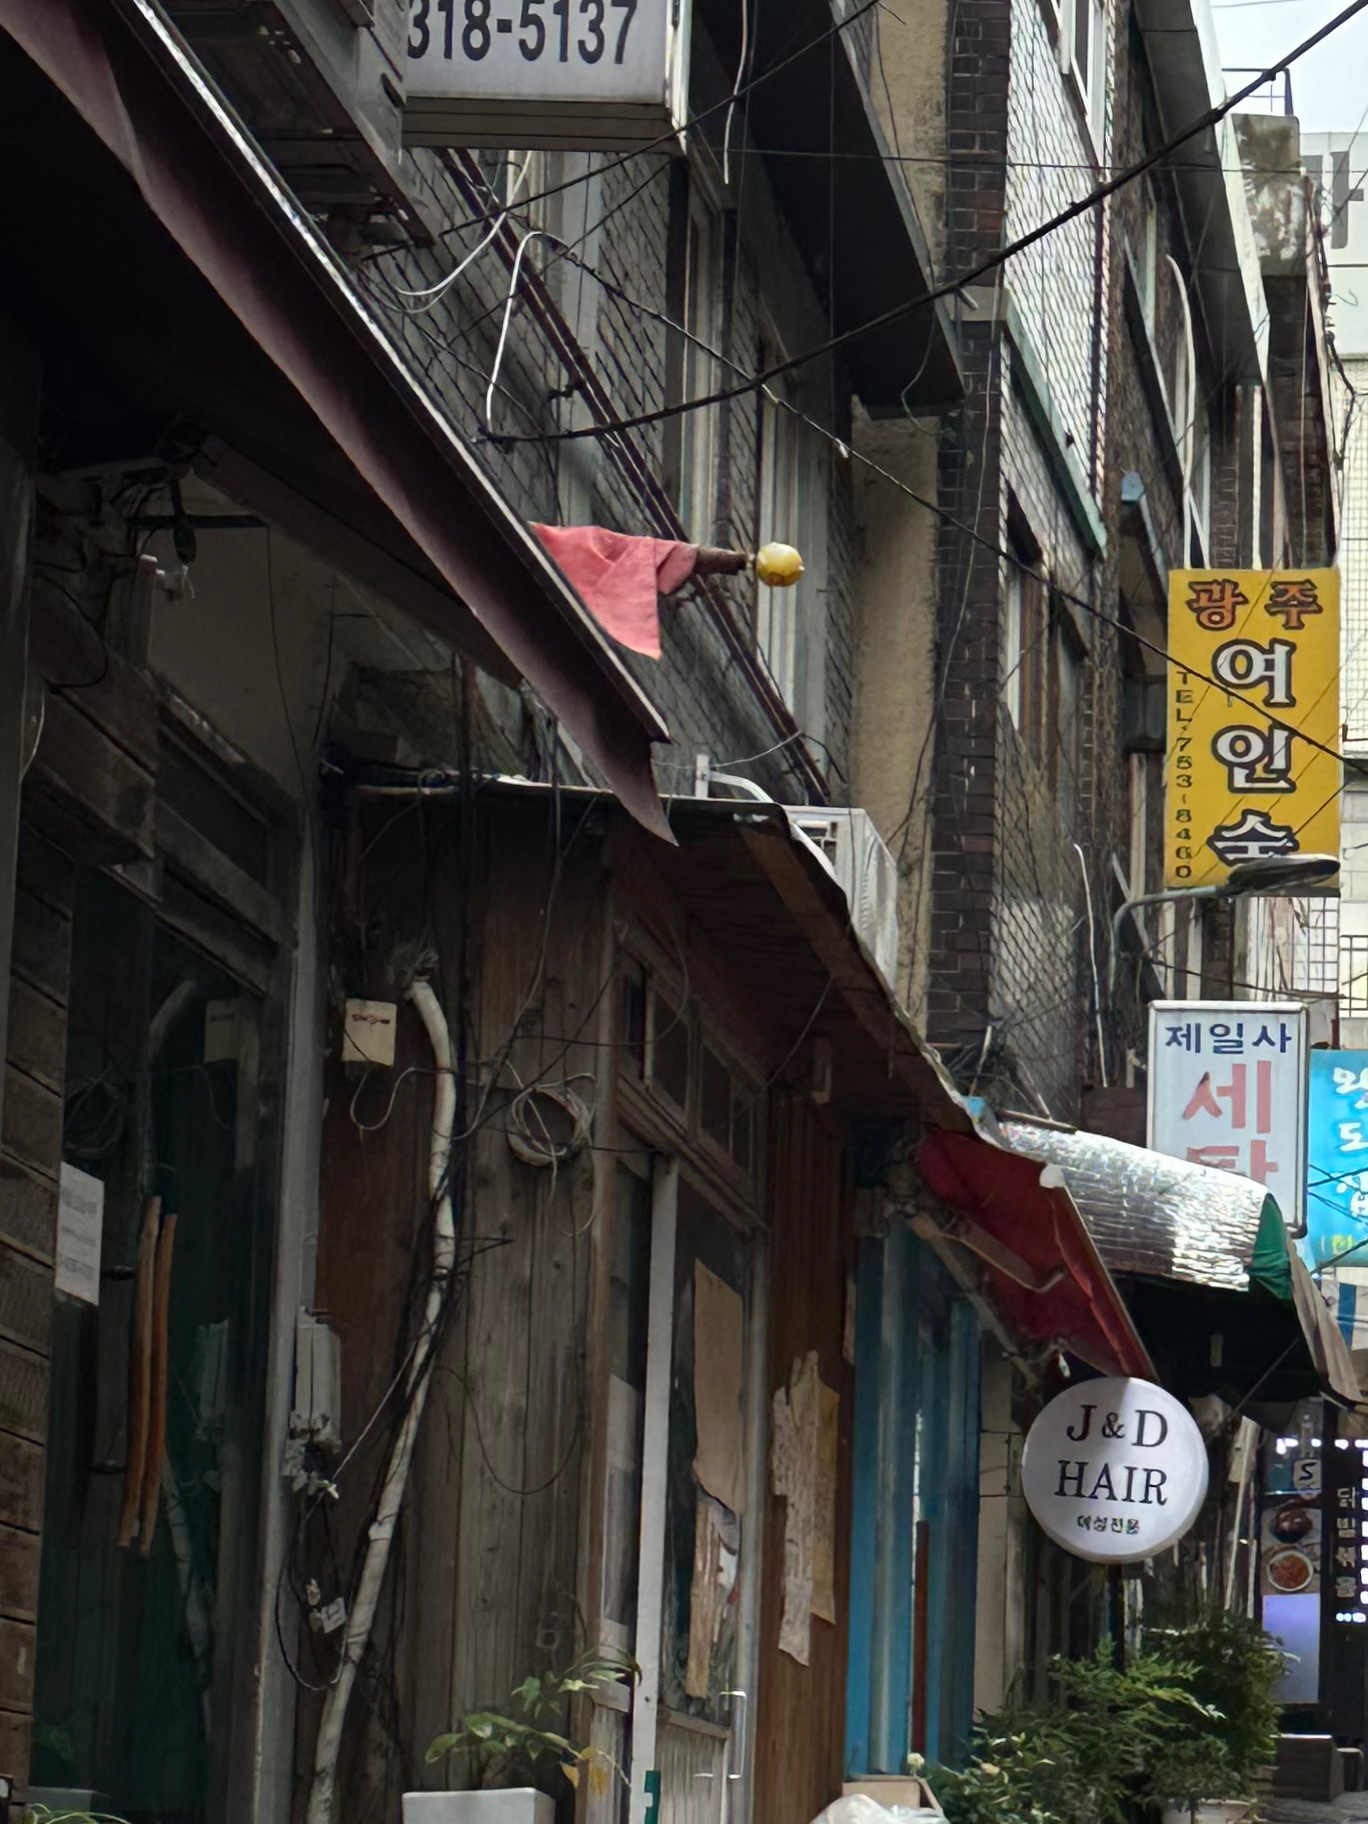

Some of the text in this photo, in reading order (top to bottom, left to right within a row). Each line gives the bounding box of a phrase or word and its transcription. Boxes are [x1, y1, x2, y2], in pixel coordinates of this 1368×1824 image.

[407, 0, 638, 65] 318-5137
[1185, 578, 1324, 632] 광주
[1206, 636, 1300, 867] 여인숙
[1165, 1023, 1293, 1055] 제일사
[1066, 1404, 1169, 1448] J&D
[1054, 1459, 1169, 1506] HAIR
